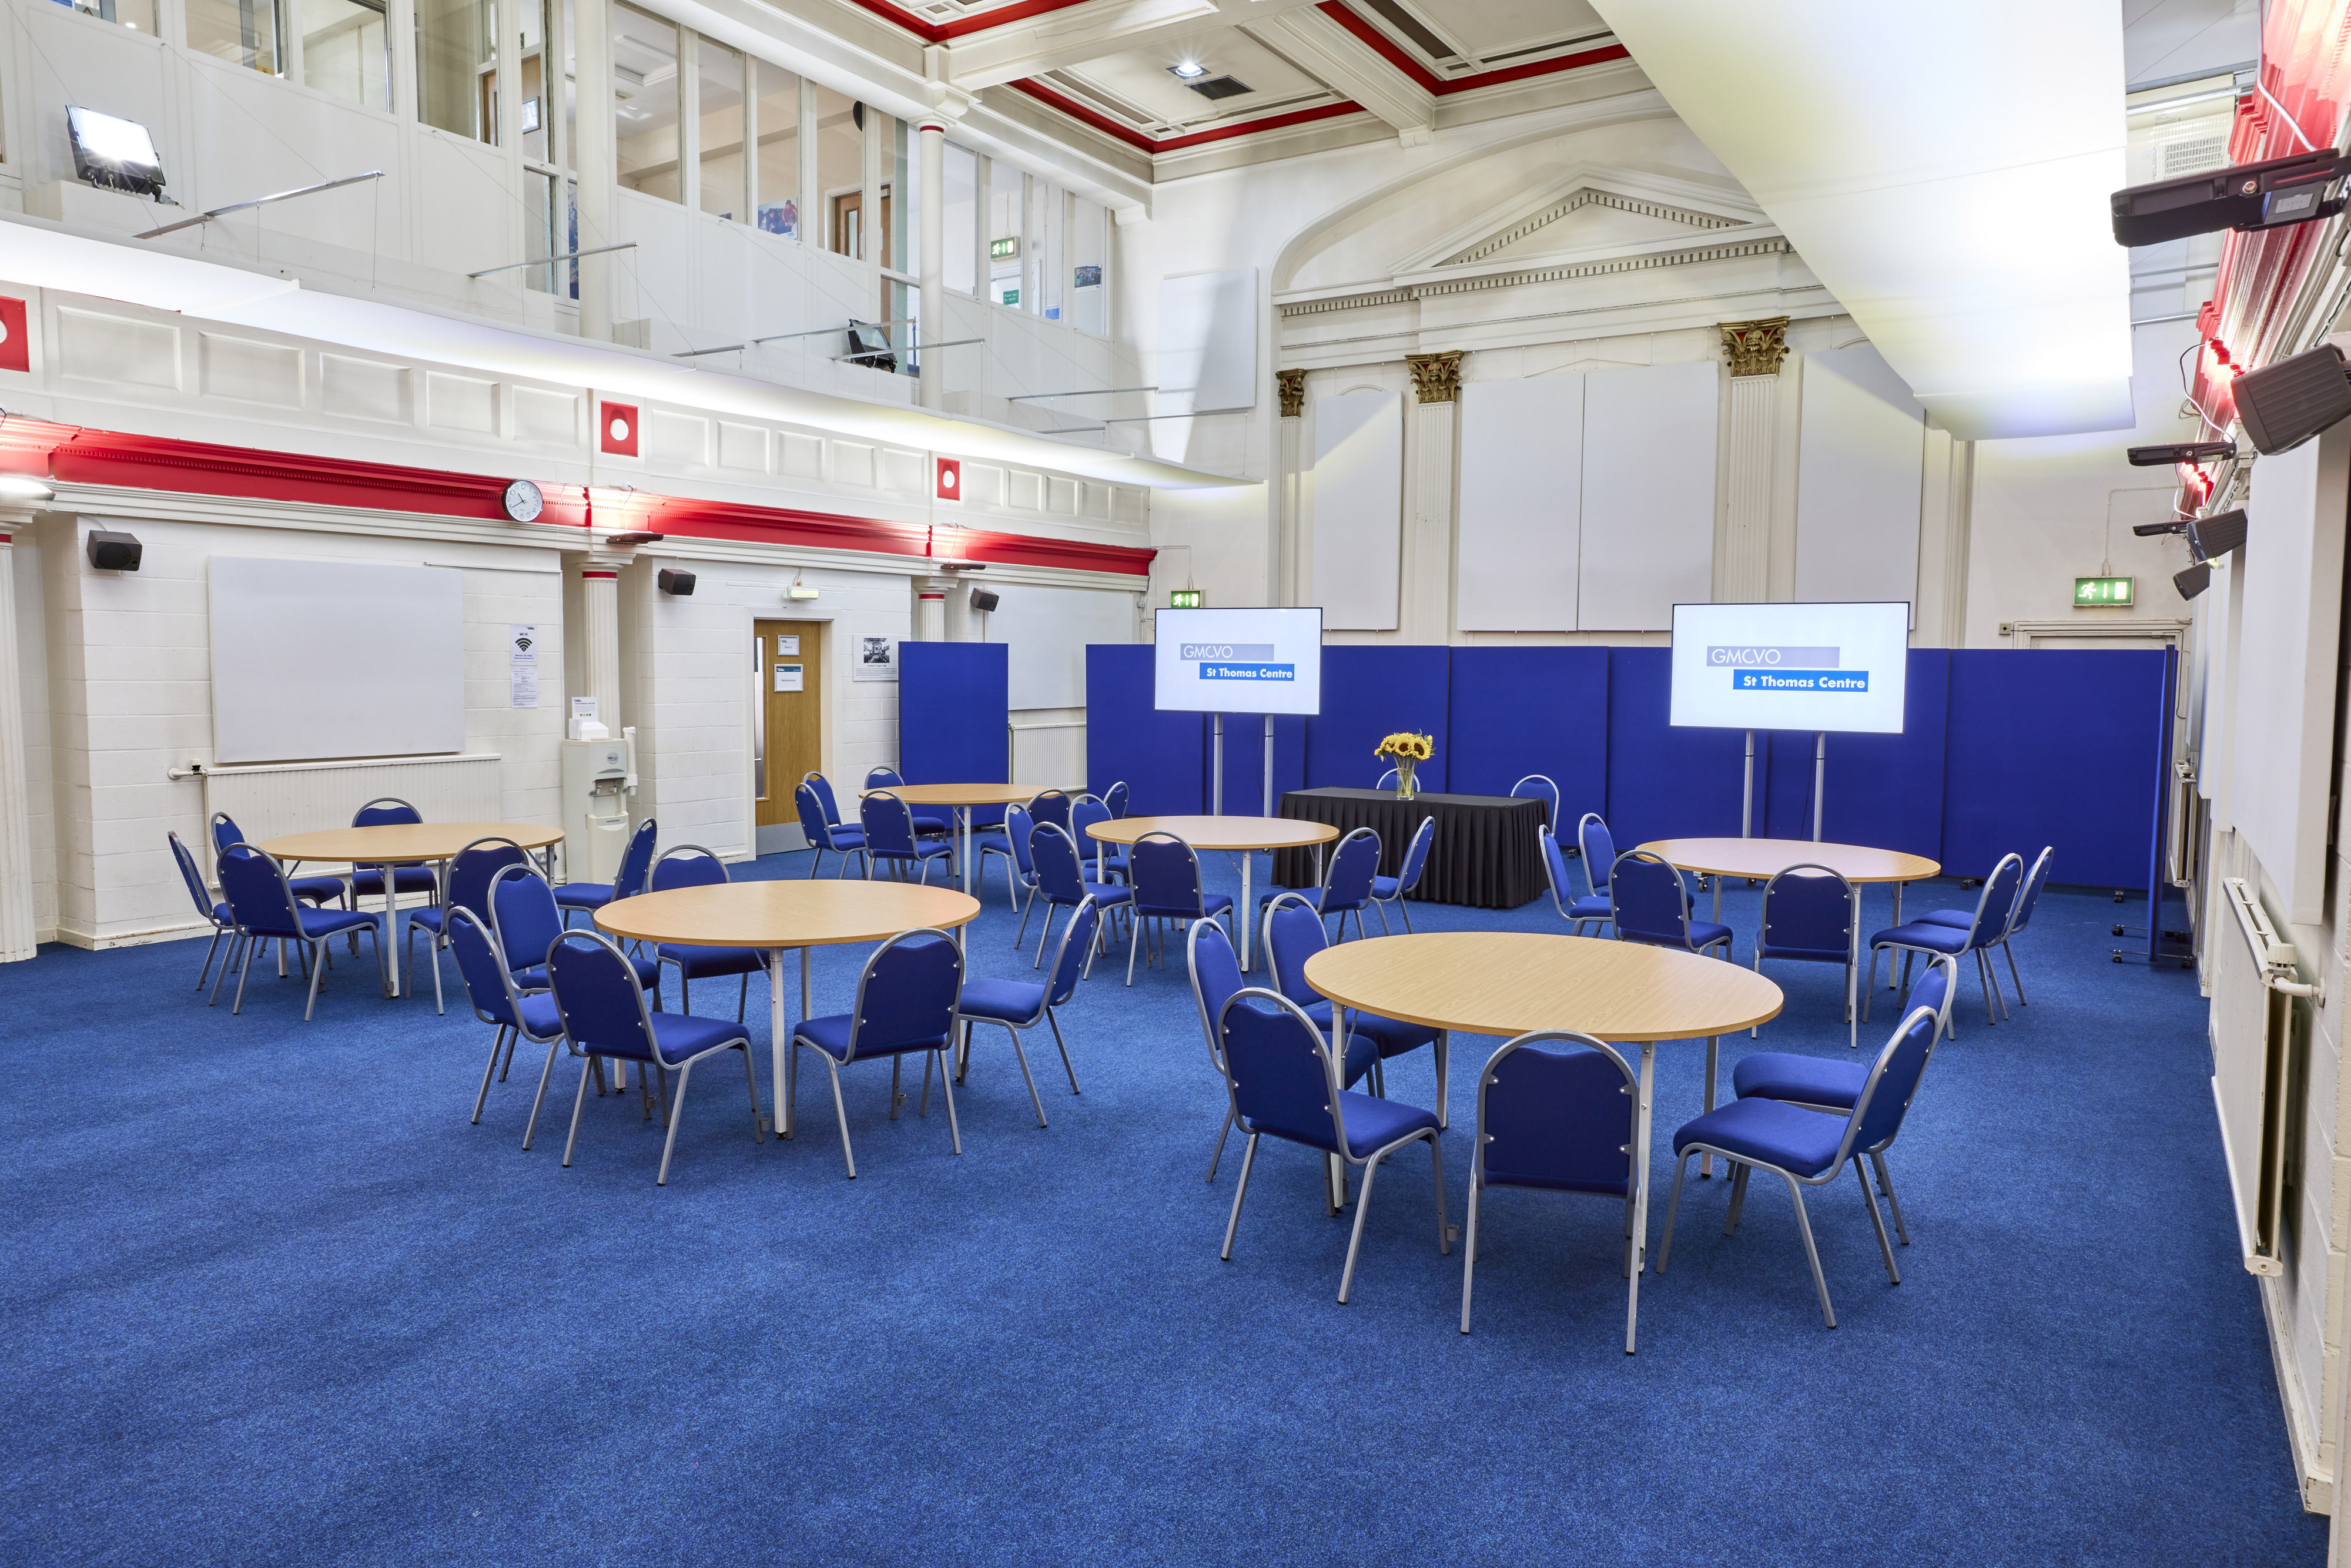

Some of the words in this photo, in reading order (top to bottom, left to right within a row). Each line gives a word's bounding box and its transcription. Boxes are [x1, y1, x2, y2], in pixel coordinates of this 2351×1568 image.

[1184, 645, 1233, 658] GMCVO
[1712, 648, 1781, 664] GMCVO
[1207, 668, 1216, 677] St
[1219, 668, 1257, 678] Thomas
[1260, 669, 1292, 678] Centre
[1743, 676, 1757, 686] St
[1761, 676, 1814, 688] Thomas
[1818, 677, 1866, 689] Centre
